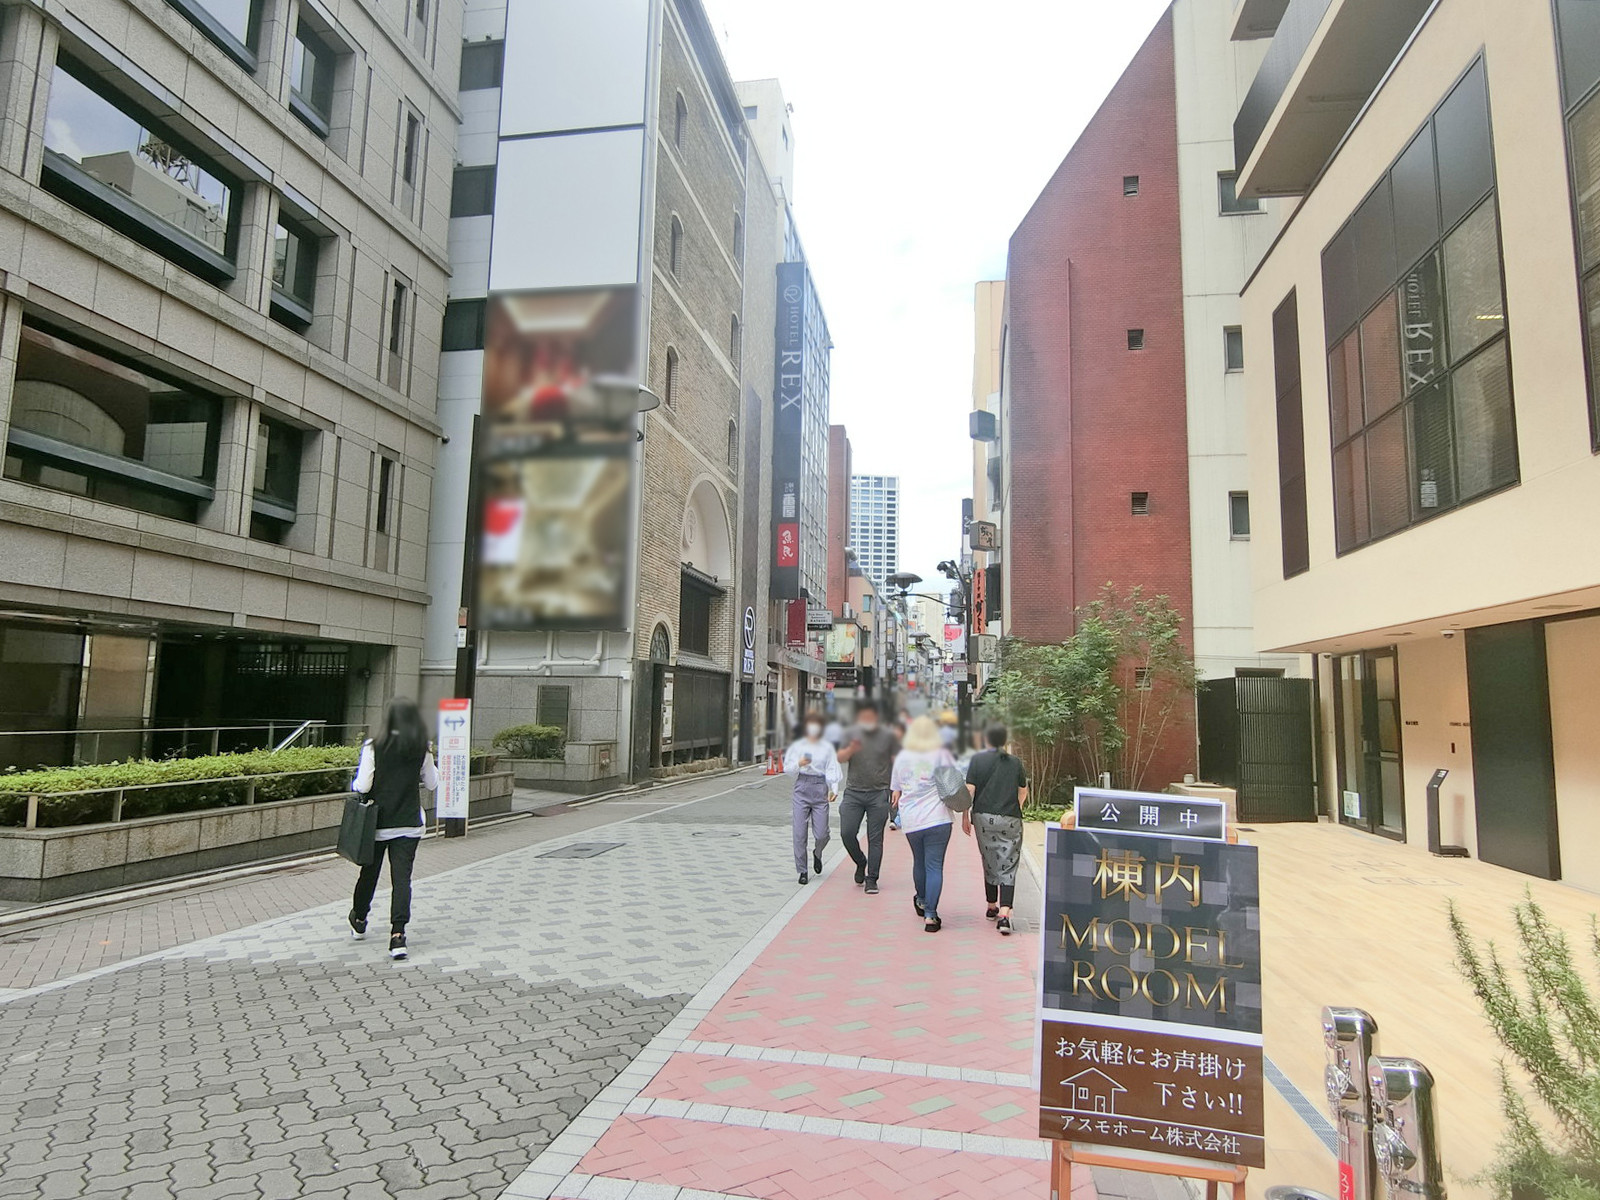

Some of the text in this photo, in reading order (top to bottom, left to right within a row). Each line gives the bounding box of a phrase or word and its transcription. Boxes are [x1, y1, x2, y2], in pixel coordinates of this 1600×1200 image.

[781, 306, 802, 412] HOTEL REX
[743, 658, 755, 674] REX
[1100, 802, 1199, 828] 公開中
[1092, 848, 1202, 908] 棟内
[1057, 913, 1245, 969] MODEL
[1071, 959, 1229, 1014] ROOM
[1054, 1036, 1246, 1080] お気軽にお声掛け
[1059, 1114, 1242, 1156] アスモホーム株式会社
